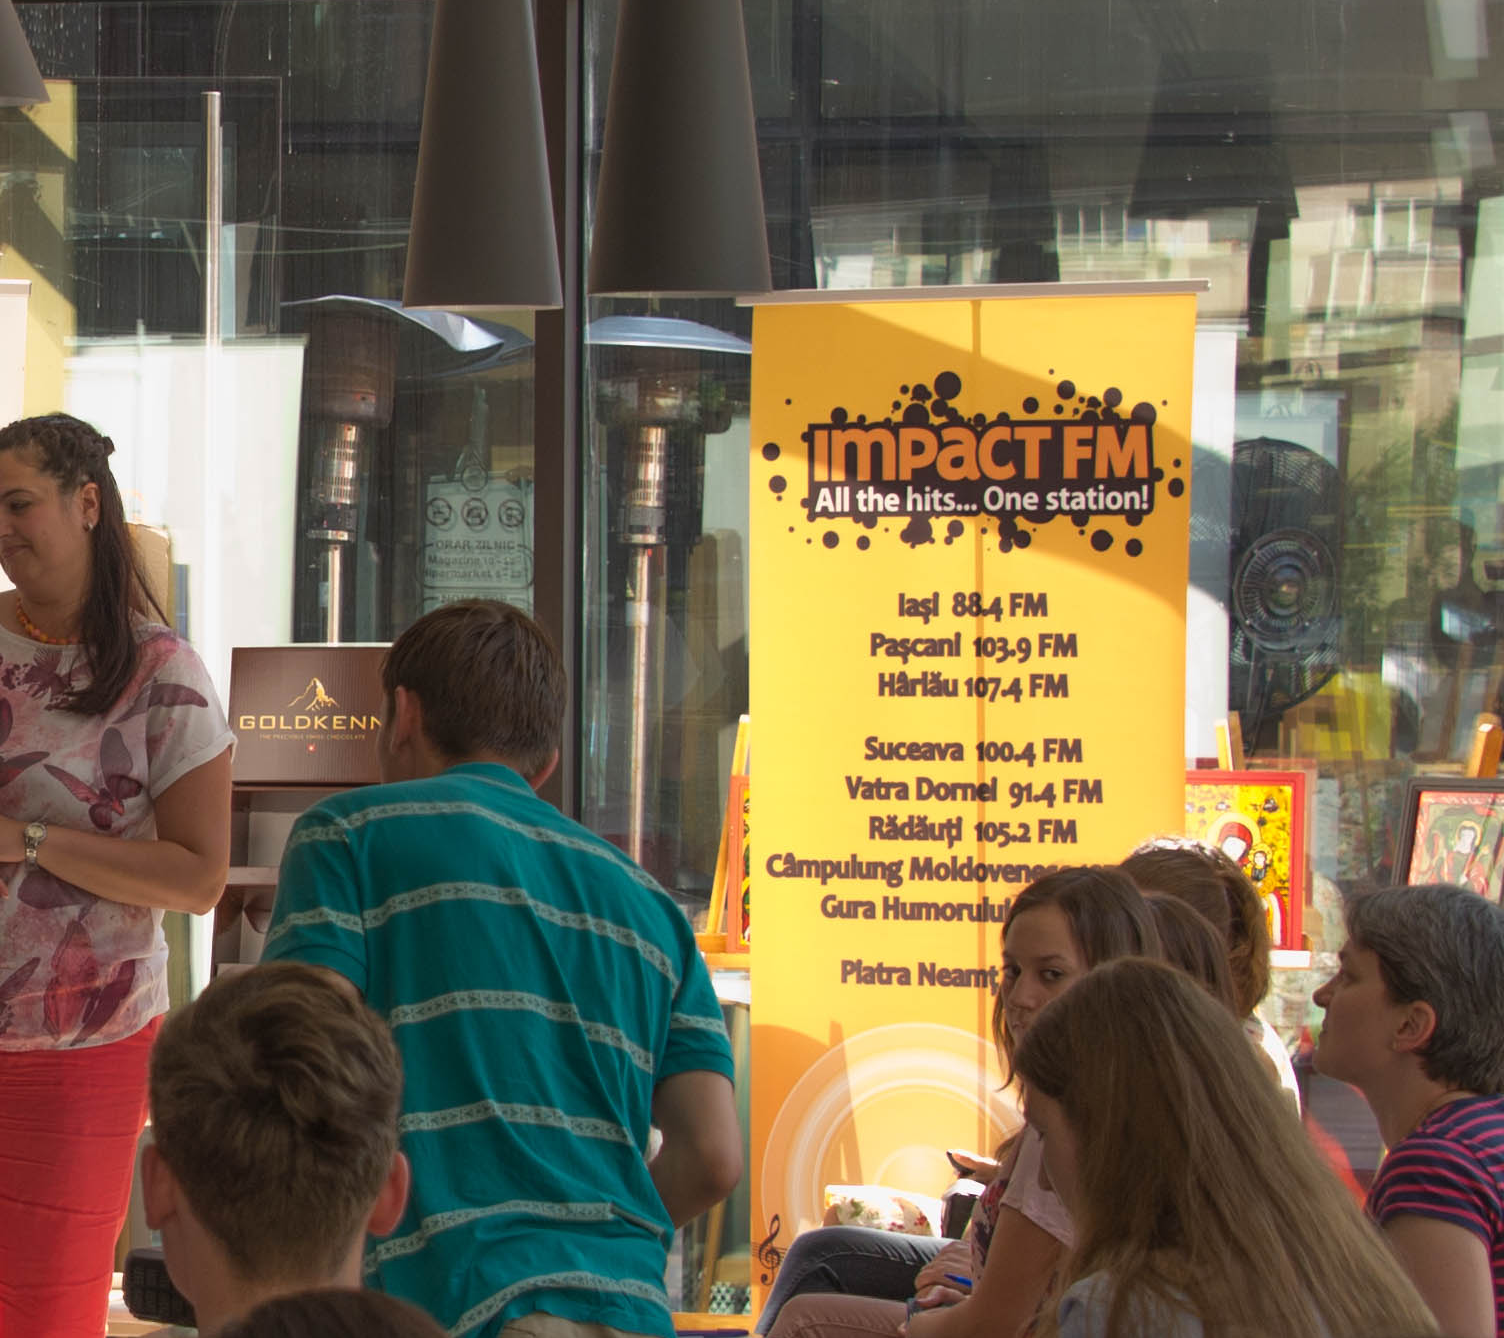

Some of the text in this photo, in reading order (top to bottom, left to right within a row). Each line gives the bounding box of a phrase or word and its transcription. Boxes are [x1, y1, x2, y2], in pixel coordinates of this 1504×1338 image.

[1063, 425, 1150, 480] FM
[814, 486, 1150, 513] All the hits... One station!
[898, 592, 1049, 625] Iași 88.4 FM
[870, 631, 1079, 666] Pașcani 103.9 FM
[878, 670, 1070, 703] Hârlău 107.4 FM
[239, 714, 383, 731] GOLDKENN
[864, 737, 1083, 768] Suceava 100.4 FM
[845, 776, 1103, 808] Vatra Dornei 91.4 FM
[869, 815, 1079, 849] Rădăuți 105.2 FM
[766, 853, 1066, 888] Câmpulung Moldovene
[821, 895, 877, 920] Gura
[841, 960, 1000, 996] Piatra Neamț
